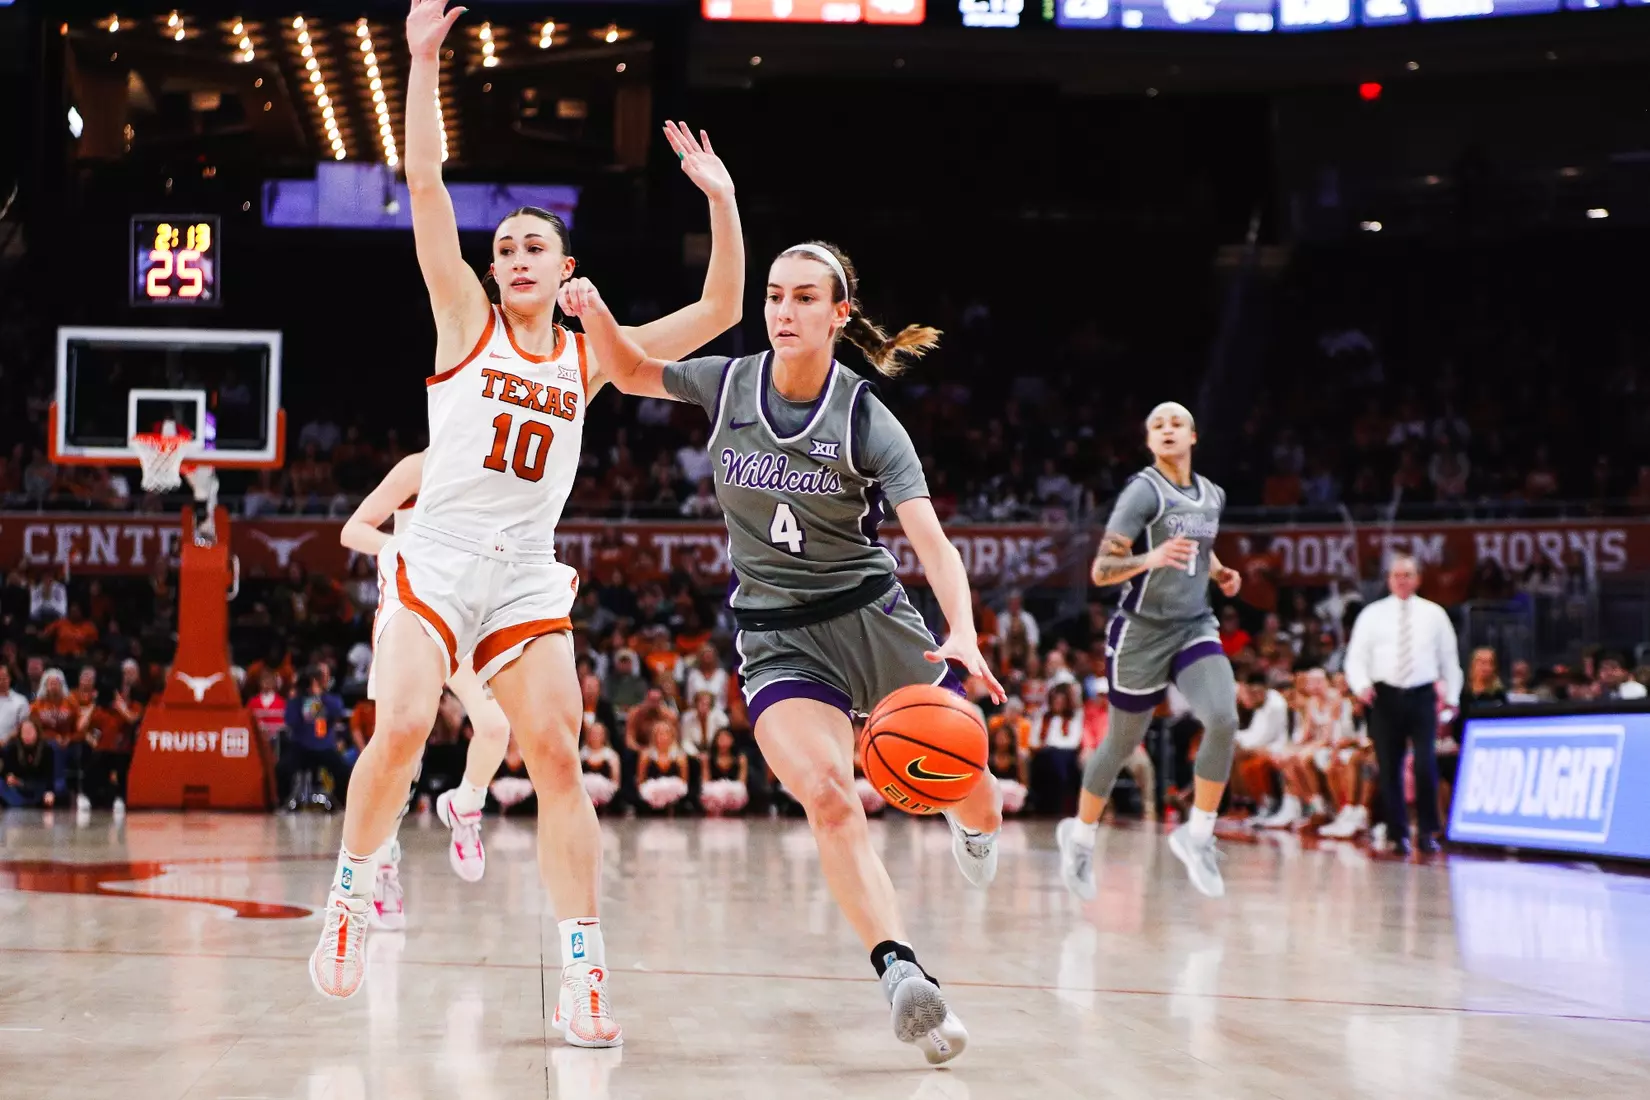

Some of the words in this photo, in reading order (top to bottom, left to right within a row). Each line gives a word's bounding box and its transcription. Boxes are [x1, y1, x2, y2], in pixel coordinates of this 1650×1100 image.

[147, 249, 203, 297] 25
[481, 368, 578, 422] TEXAS
[483, 412, 555, 483] 10
[721, 447, 843, 495] Wildcats
[809, 438, 840, 460] XII
[23, 524, 183, 567] CENTE
[769, 502, 806, 556] 4
[1238, 534, 1356, 577] OOK
[1474, 529, 1627, 574] HORNS
[147, 731, 220, 753] TRUIST
[880, 783, 938, 813] ELIT
[1463, 746, 1526, 815] BUD
[1518, 745, 1615, 821] LIGHT
